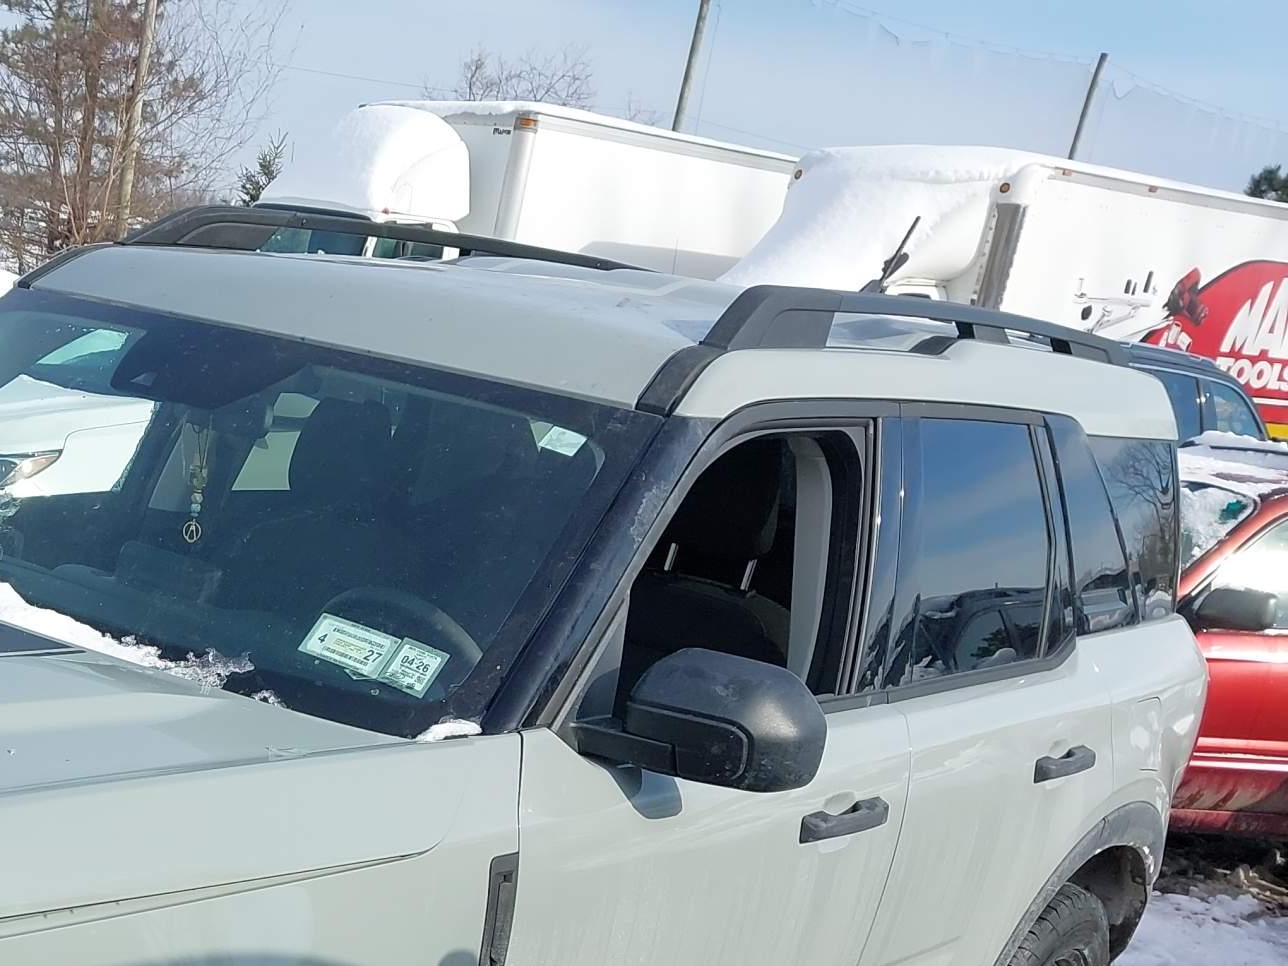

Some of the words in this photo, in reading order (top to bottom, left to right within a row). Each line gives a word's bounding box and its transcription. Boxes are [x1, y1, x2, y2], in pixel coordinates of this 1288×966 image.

[1219, 277, 1288, 360] MA
[318, 633, 328, 643] 4
[363, 649, 383, 663] 27
[400, 655, 431, 673] 04-26
